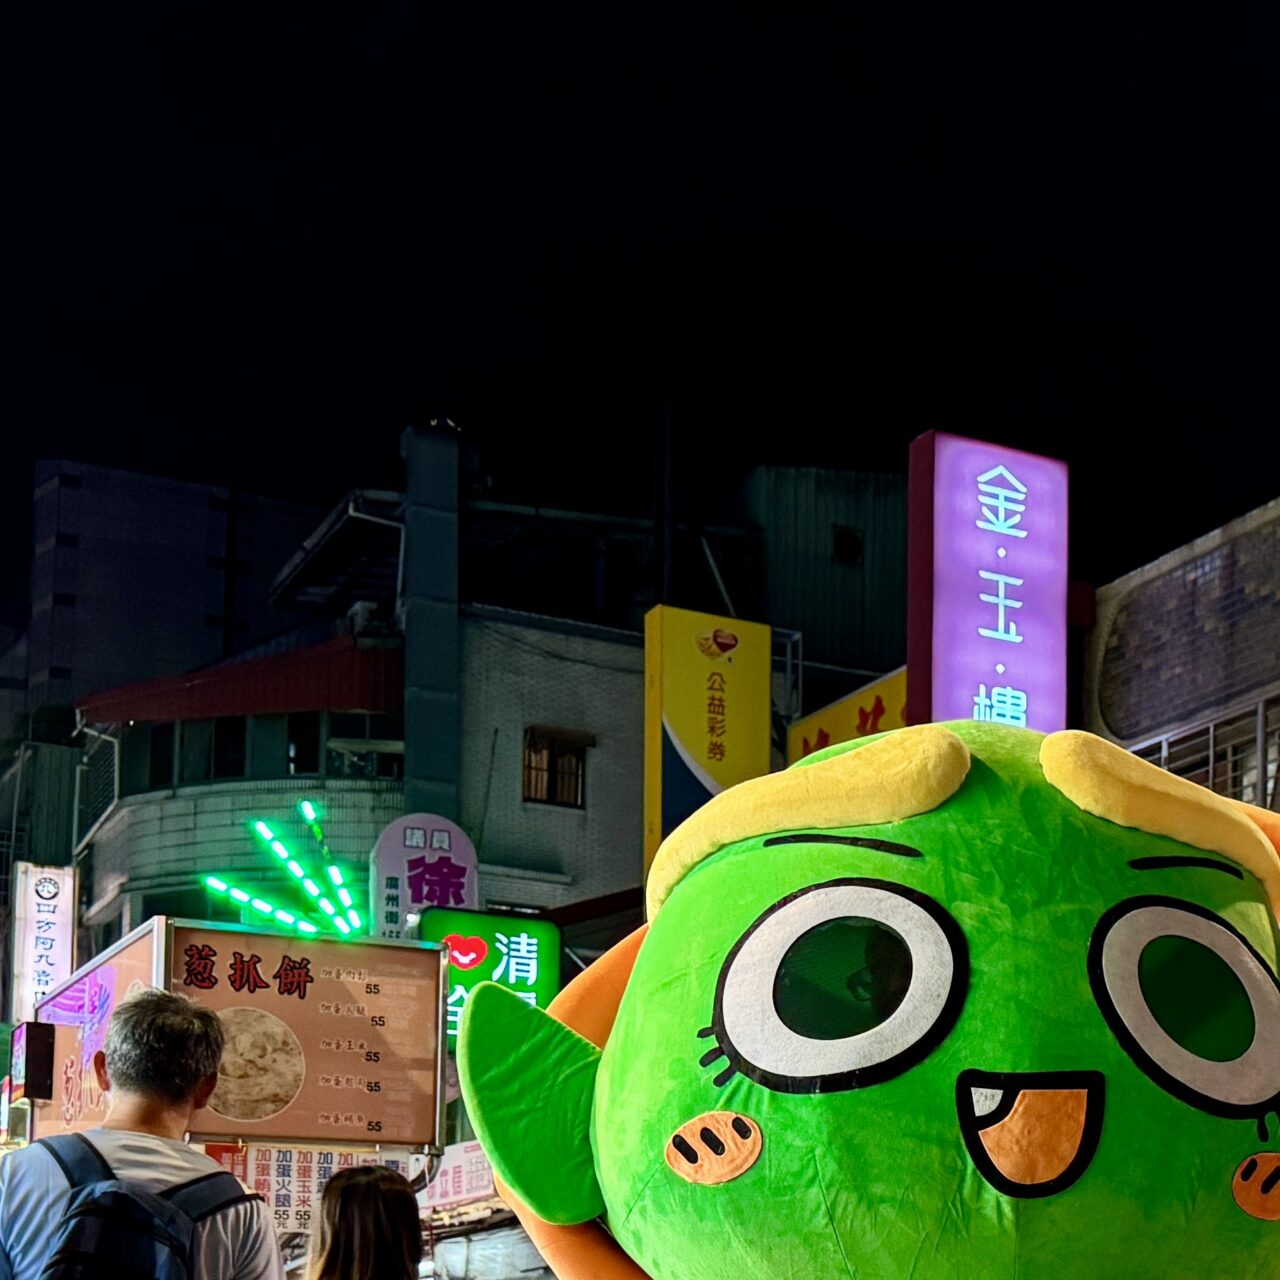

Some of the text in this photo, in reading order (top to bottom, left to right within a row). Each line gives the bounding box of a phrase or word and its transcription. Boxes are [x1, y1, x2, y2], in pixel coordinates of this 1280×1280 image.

[706, 671, 727, 762] 公益彩券
[365, 983, 381, 995] 55
[371, 1015, 386, 1027] 55
[365, 1051, 380, 1063] 55
[366, 1081, 382, 1093] 55
[367, 1120, 383, 1133] 55
[296, 1150, 313, 1209] 加蛋玉米
[273, 1209, 290, 1221] 55
[295, 1210, 311, 1221] 55
